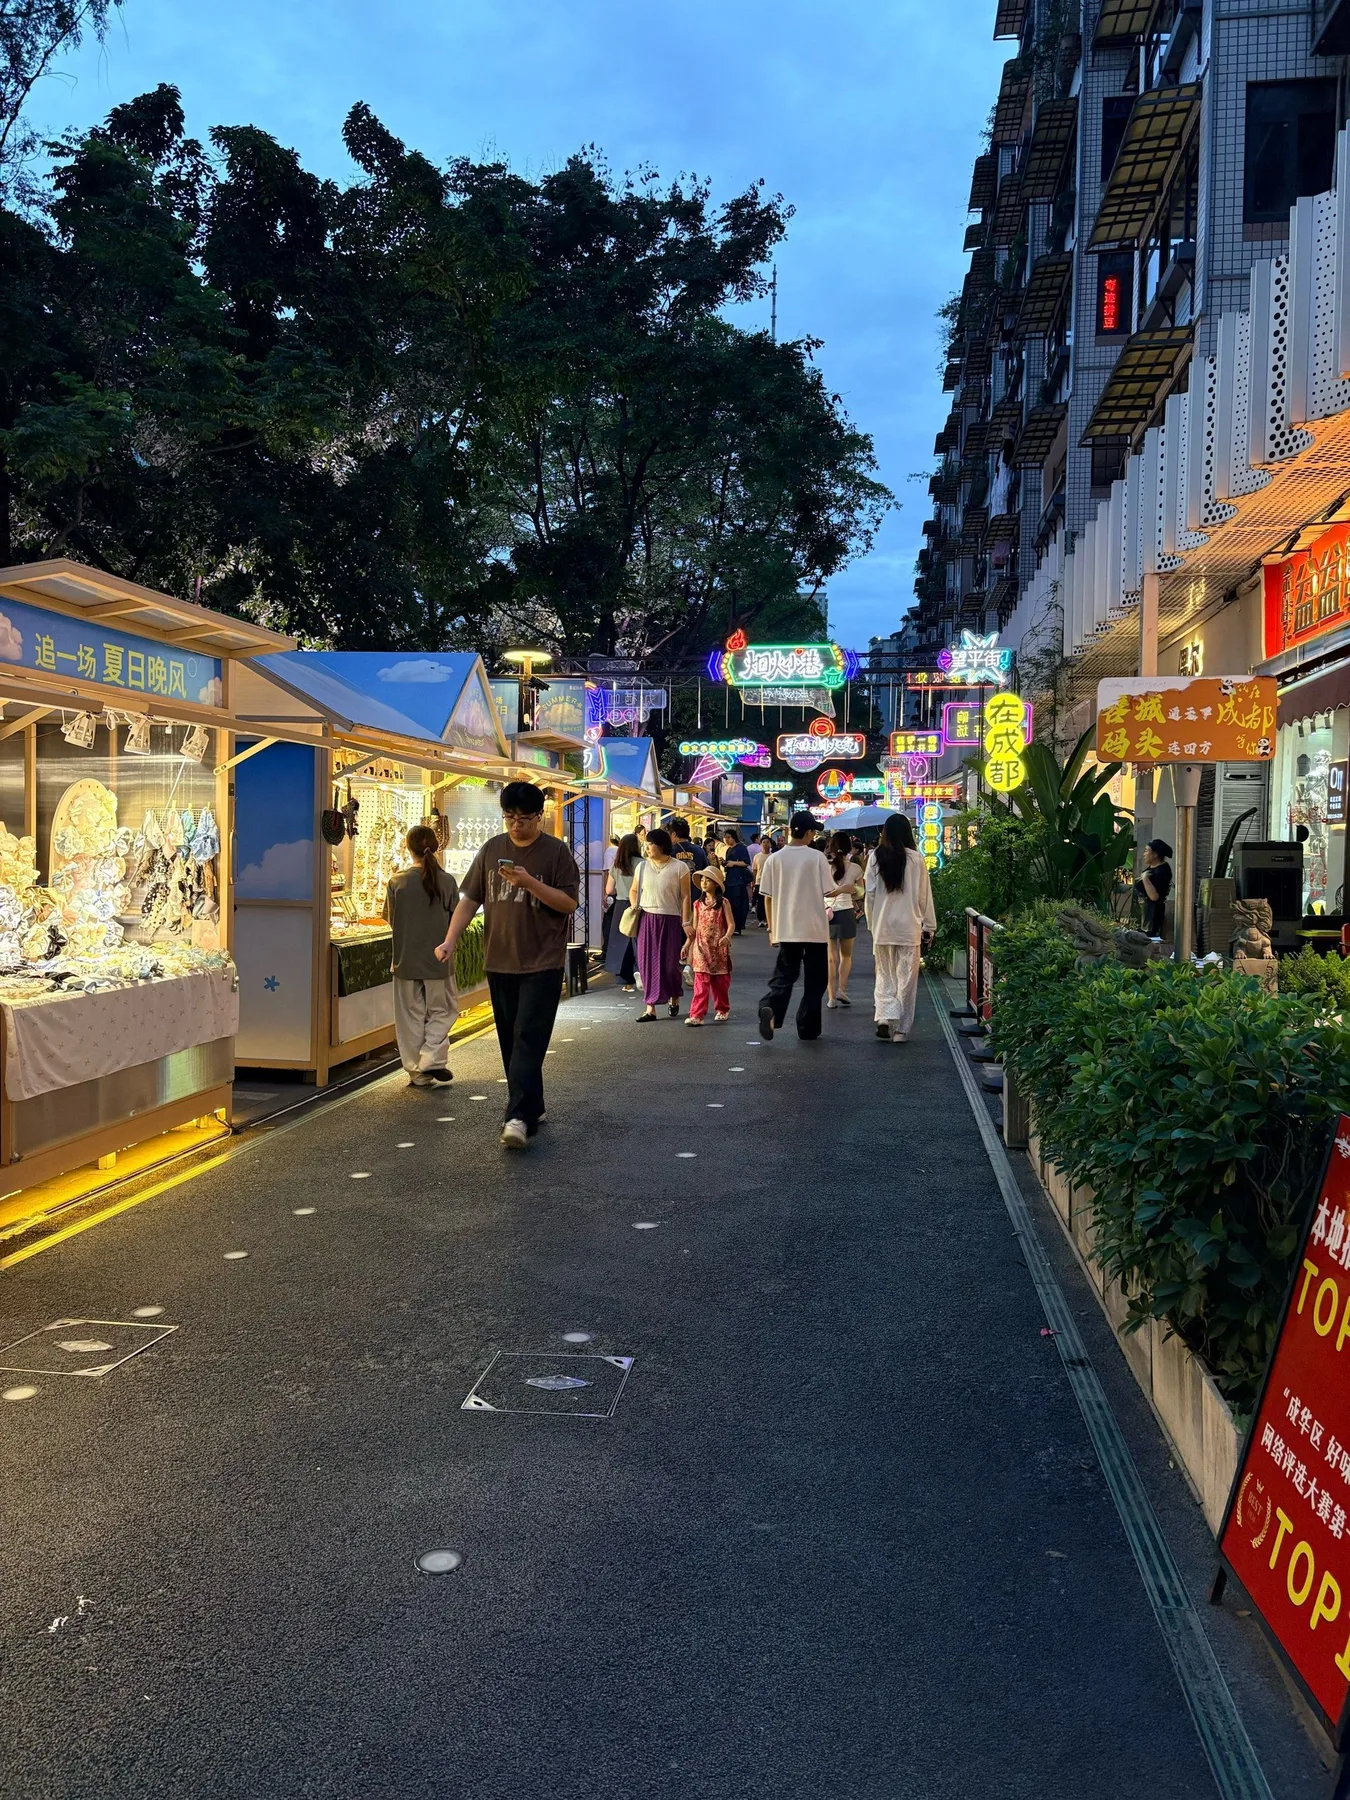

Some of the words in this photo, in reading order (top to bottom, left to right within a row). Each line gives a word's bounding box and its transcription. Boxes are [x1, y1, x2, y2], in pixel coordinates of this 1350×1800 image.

[35, 633, 97, 680] 追一场
[102, 642, 187, 699] 夏日晚风
[739, 649, 824, 681] 烟火小巷
[950, 650, 1001, 668] 望平街
[542, 696, 577, 711] SUMMER
[1167, 706, 1213, 722] 通天下
[1216, 694, 1274, 736] 成都
[989, 699, 1020, 788] 在成都
[1101, 727, 1166, 759] 码头
[1167, 740, 1213, 756] 连四方
[1261, 1421, 1350, 1540] 网络评选大赛第
[1269, 1506, 1342, 1631] TOP
